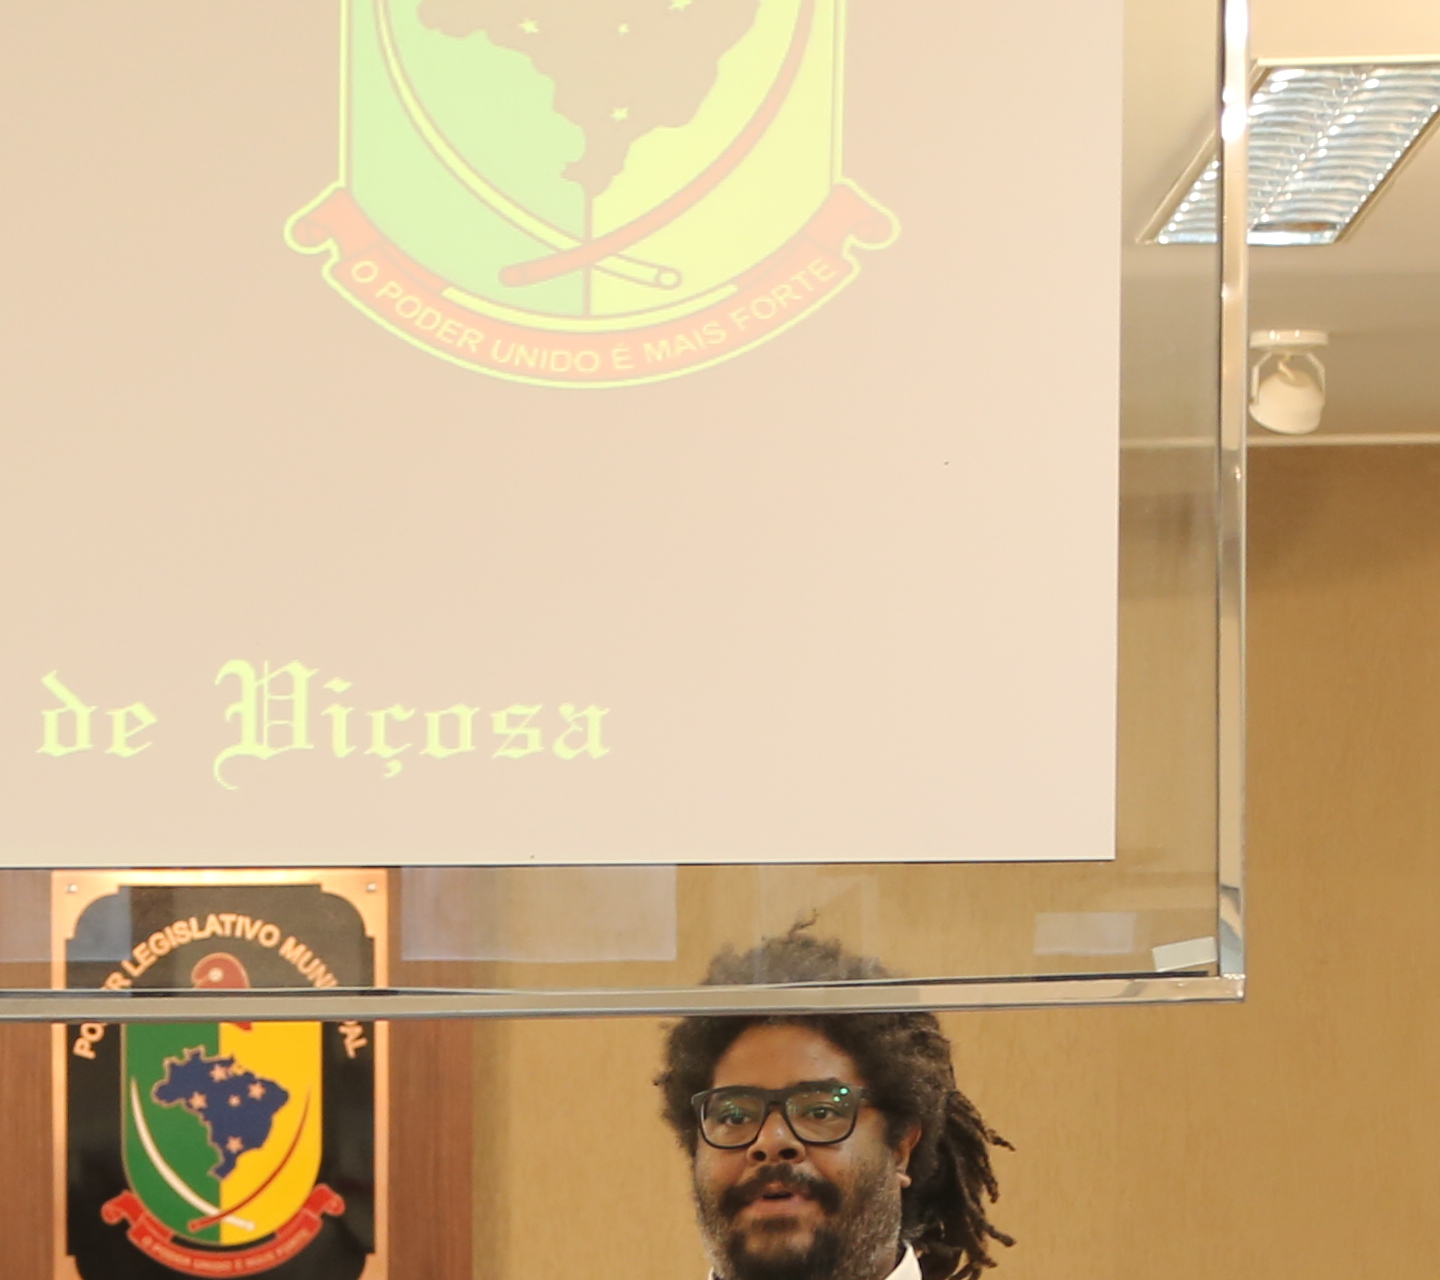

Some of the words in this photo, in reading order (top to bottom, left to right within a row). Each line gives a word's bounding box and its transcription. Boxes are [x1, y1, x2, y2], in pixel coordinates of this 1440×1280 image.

[350, 259, 380, 288] O
[375, 278, 483, 353] PODER
[490, 335, 601, 375] UNIDO
[612, 342, 636, 371] É
[643, 322, 728, 365] MAIS
[730, 256, 839, 334] FORTE
[35, 668, 158, 758] de
[212, 659, 612, 790] Viçosa
[121, 912, 281, 978] LEGISLATIVO
